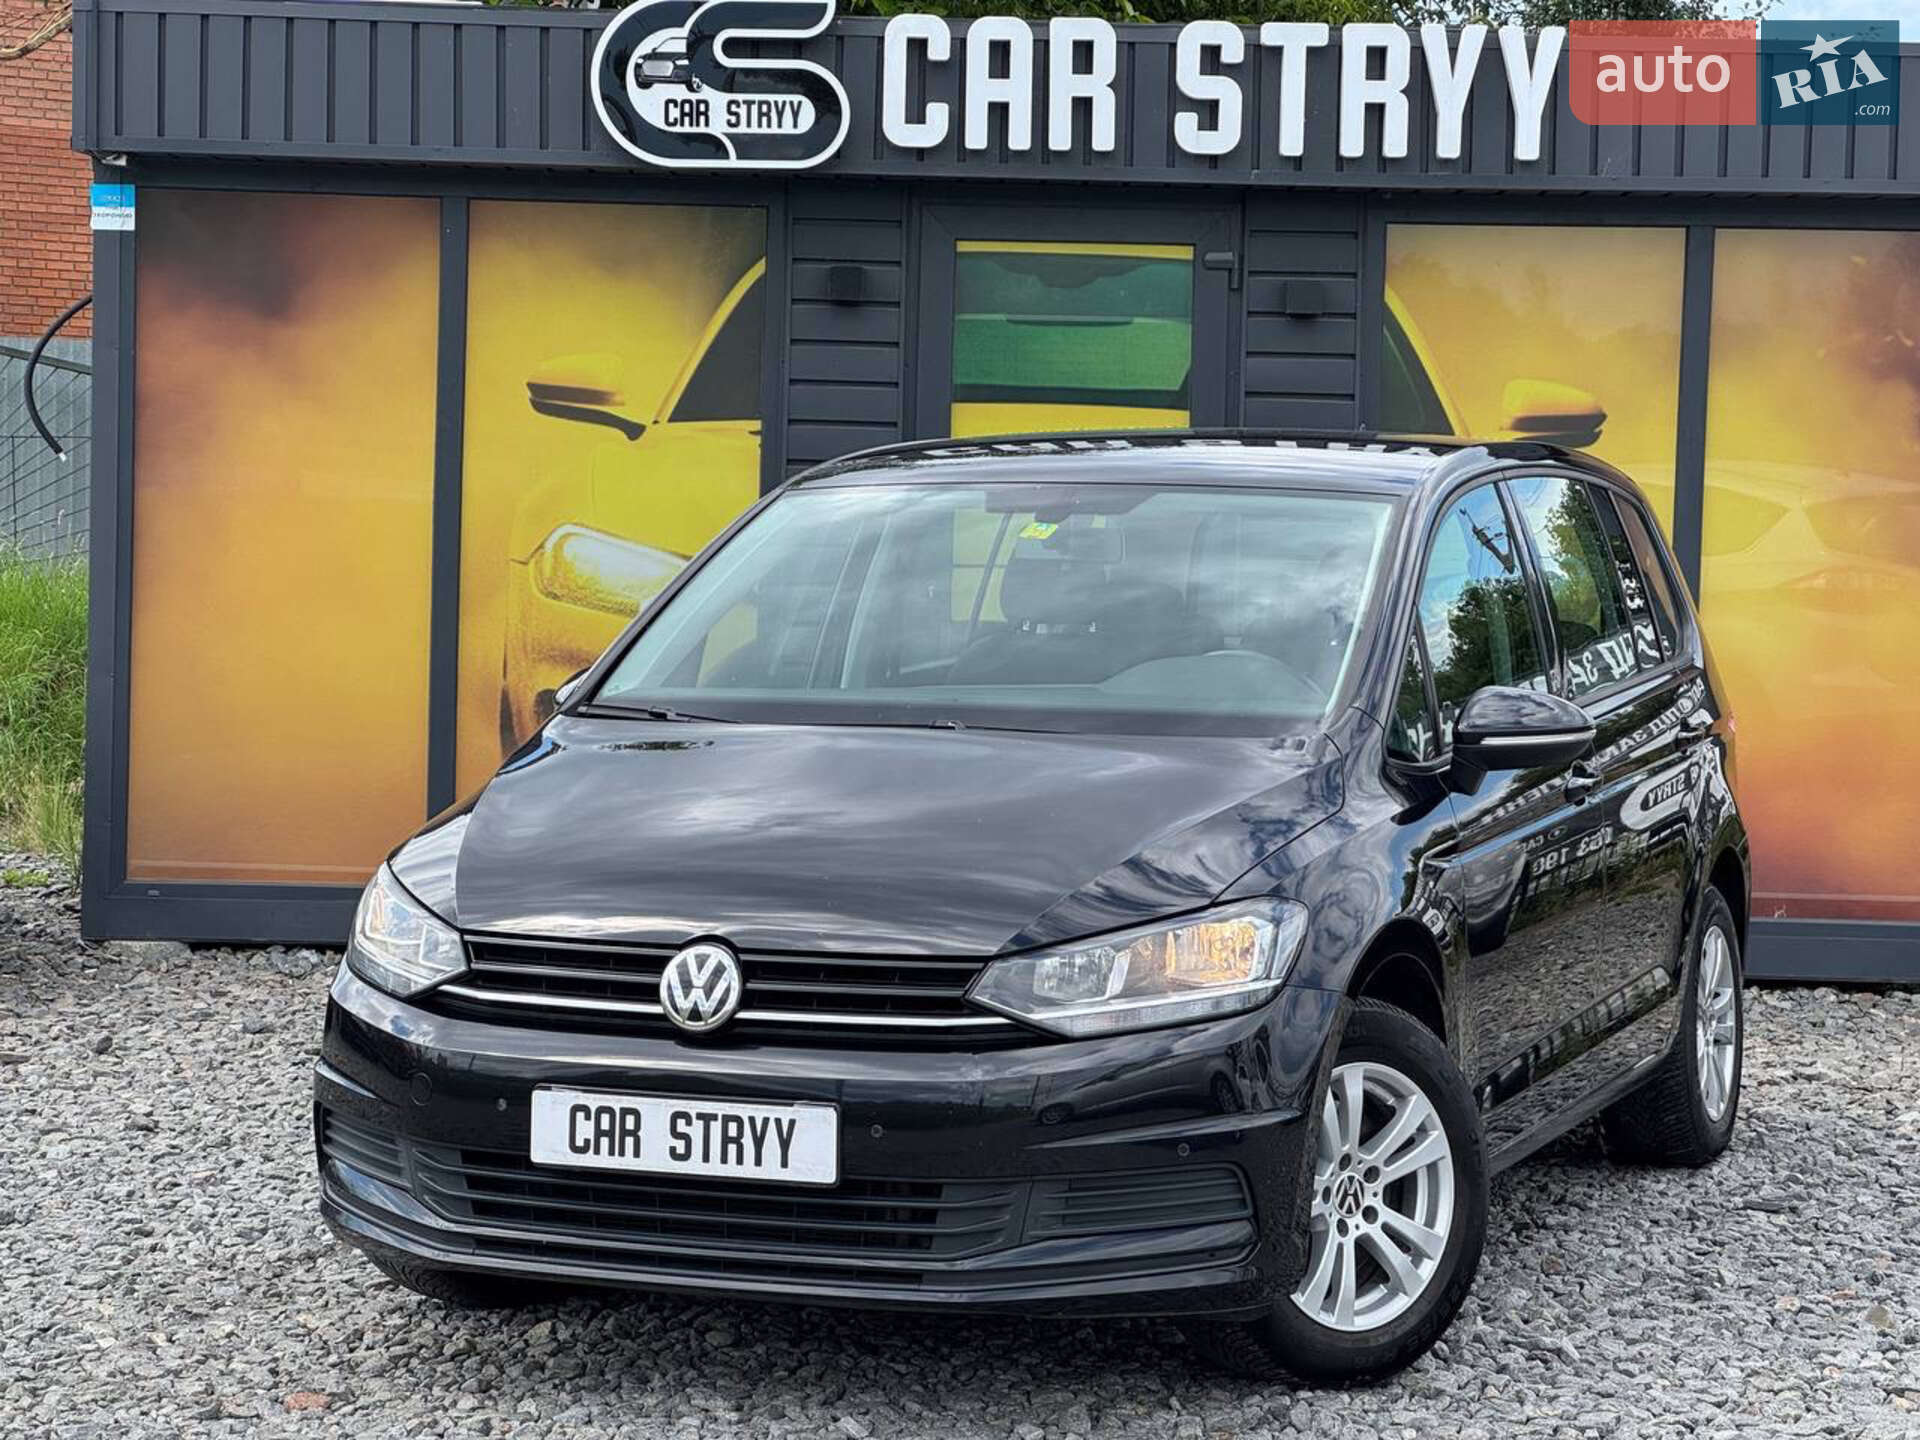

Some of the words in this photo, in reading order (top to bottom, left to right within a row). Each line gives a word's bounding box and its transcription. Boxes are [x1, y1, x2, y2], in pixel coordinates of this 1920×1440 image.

[664, 99, 710, 127] CAR
[726, 100, 803, 129] STRYY
[882, 13, 1118, 152] CAR
[1174, 19, 1566, 162] STRYY
[660, 945, 741, 1031] VW
[568, 1103, 642, 1159] CAR
[668, 1110, 797, 1169] STRYY
